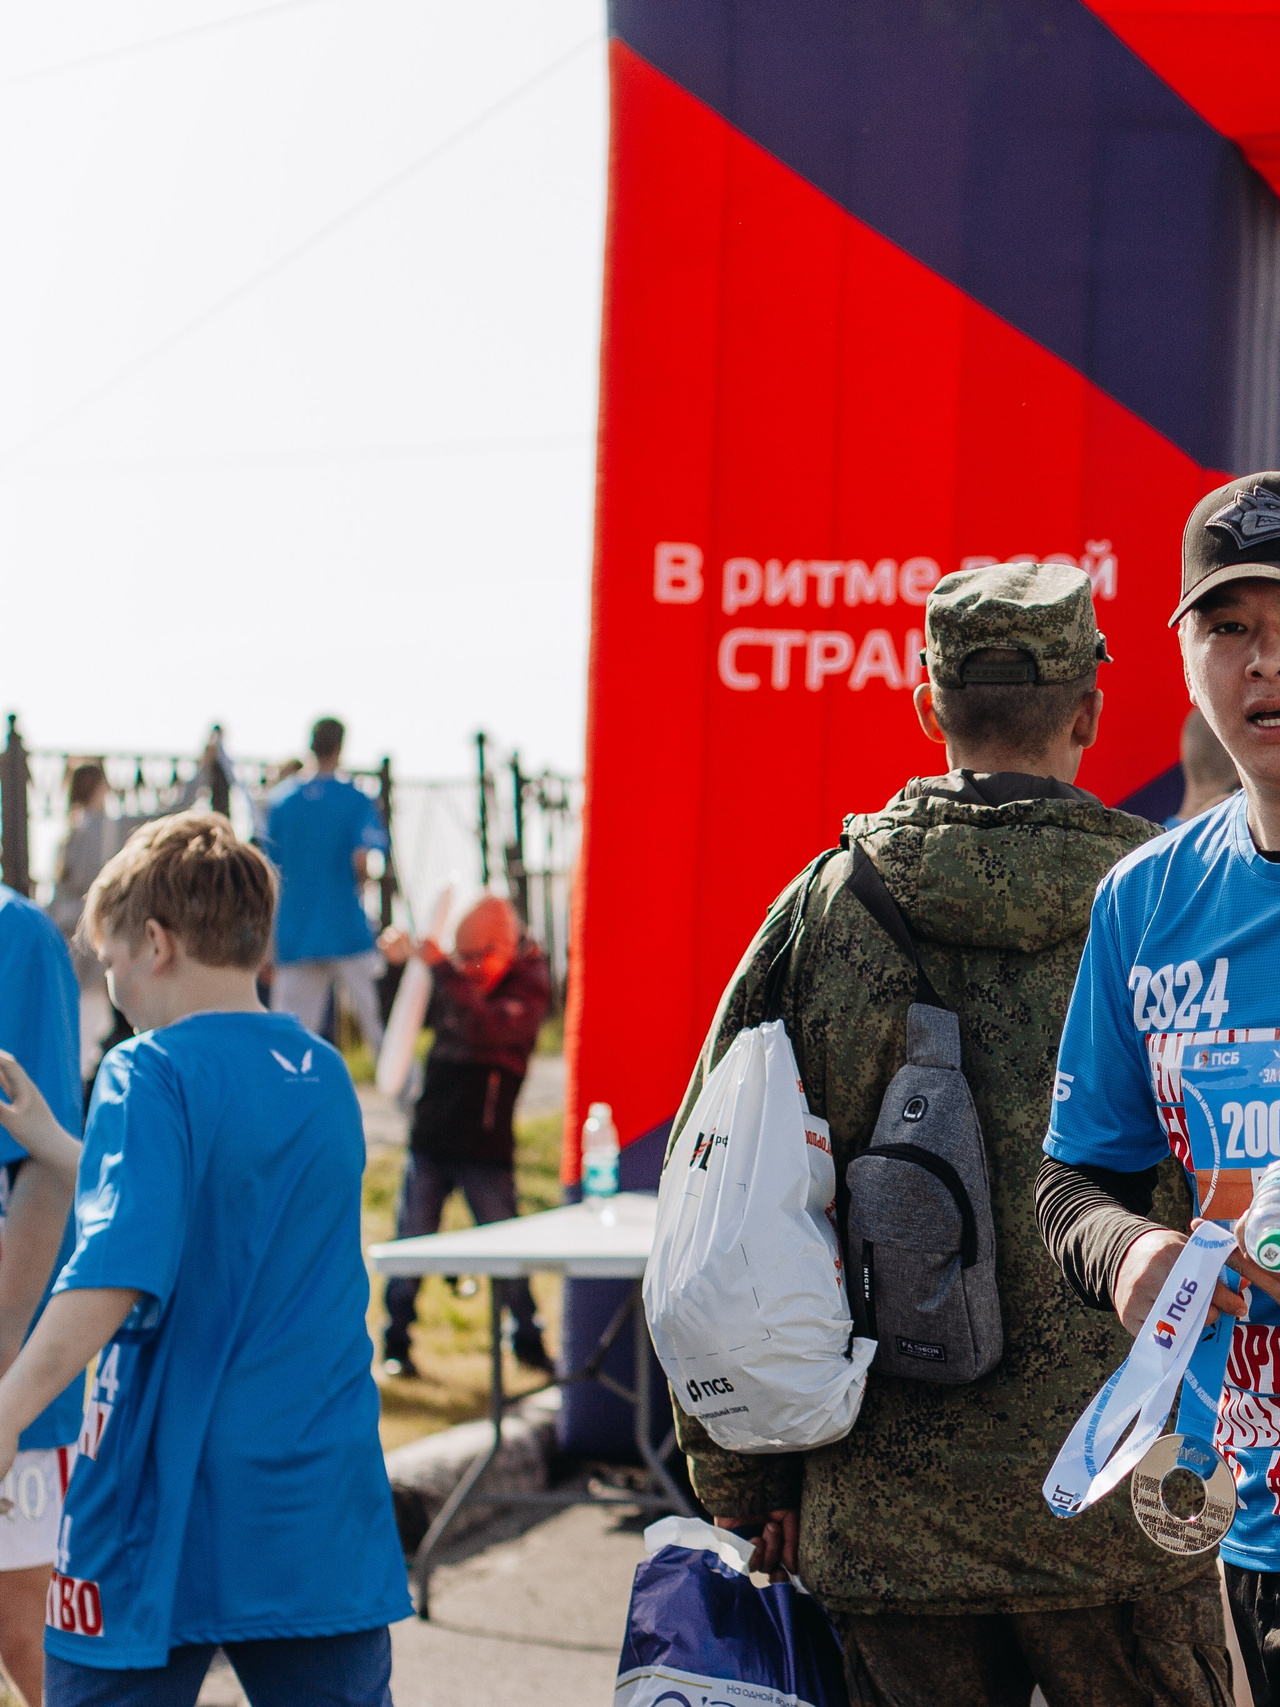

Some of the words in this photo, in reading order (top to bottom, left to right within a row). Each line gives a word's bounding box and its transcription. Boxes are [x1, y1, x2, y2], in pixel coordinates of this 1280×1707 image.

[653, 541, 703, 604] В
[722, 556, 941, 615] ритме
[1128, 957, 1230, 1031] 2024
[1211, 1051, 1240, 1066] ПСБ
[1166, 1277, 1199, 1322] ПСБ
[700, 1377, 735, 1398] ПСБ
[1084, 1411, 1100, 1453] #АДРЕНАЛИН
[1094, 1384, 1113, 1413] #МОМЕНТ
[726, 1684, 742, 1696] На
